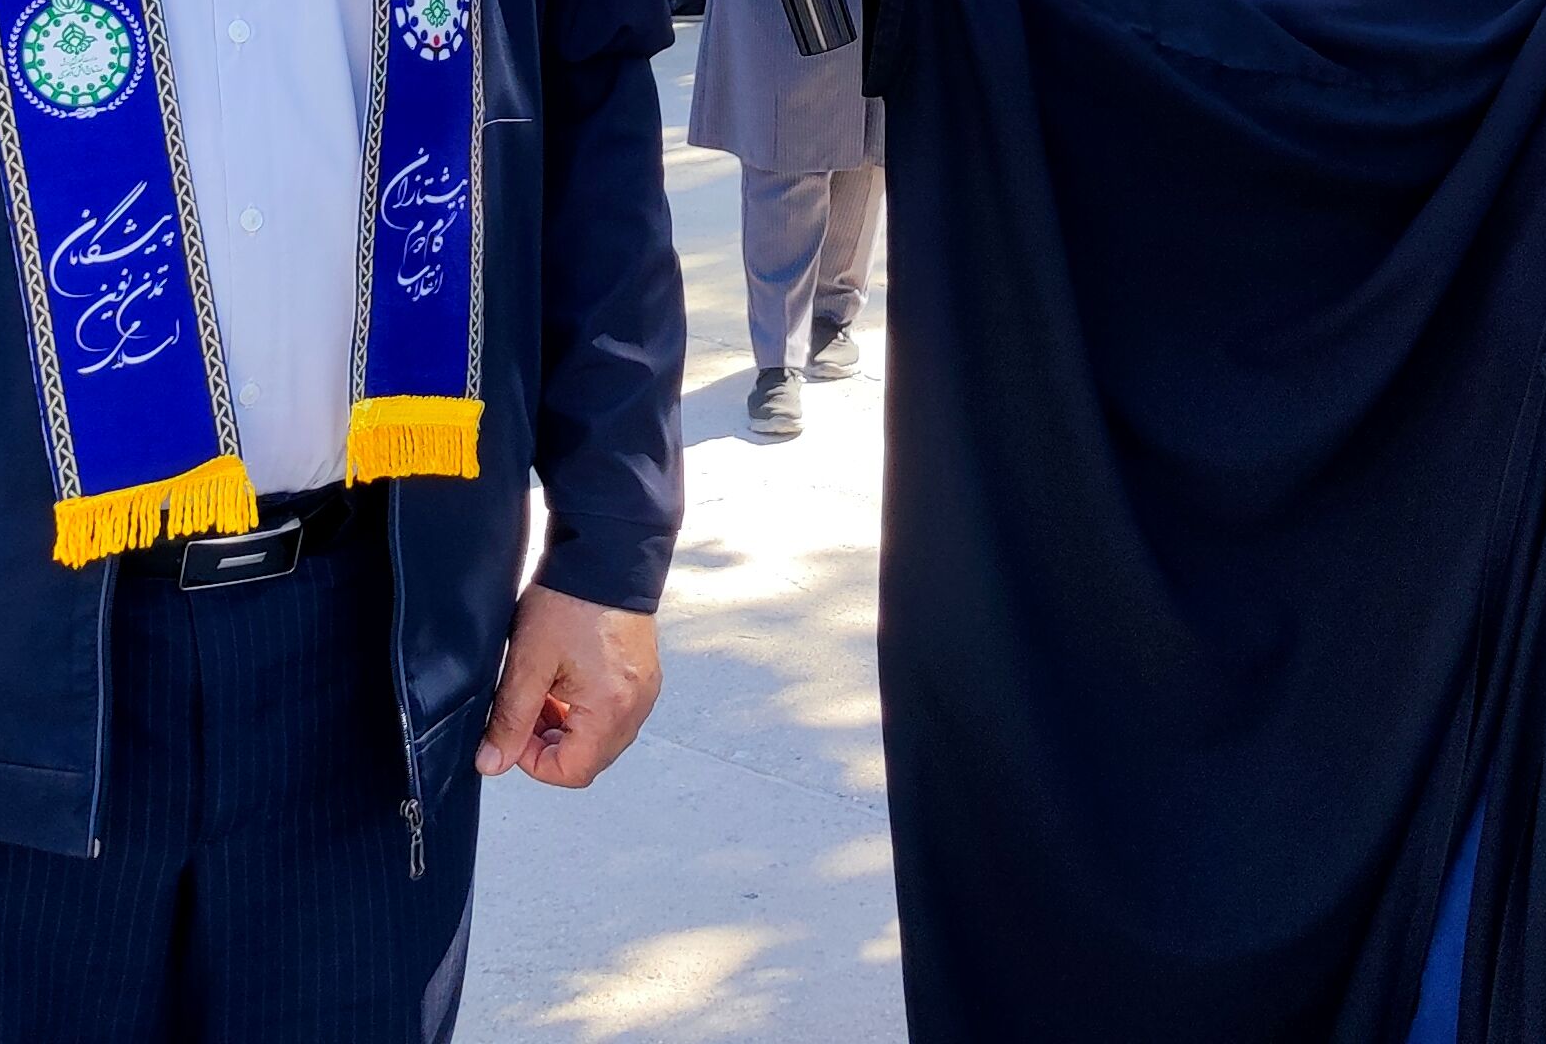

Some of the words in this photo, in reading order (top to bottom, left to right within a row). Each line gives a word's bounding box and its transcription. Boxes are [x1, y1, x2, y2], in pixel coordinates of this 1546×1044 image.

[381, 147, 468, 231] پیشتازان
[49, 180, 175, 298] پیشگامان
[402, 220, 426, 266] دوم
[424, 211, 458, 264] گام
[75, 268, 133, 352] نوین
[115, 264, 169, 340] تمدن
[397, 264, 444, 302] انقلاب
[77, 319, 180, 374] اسلامی
